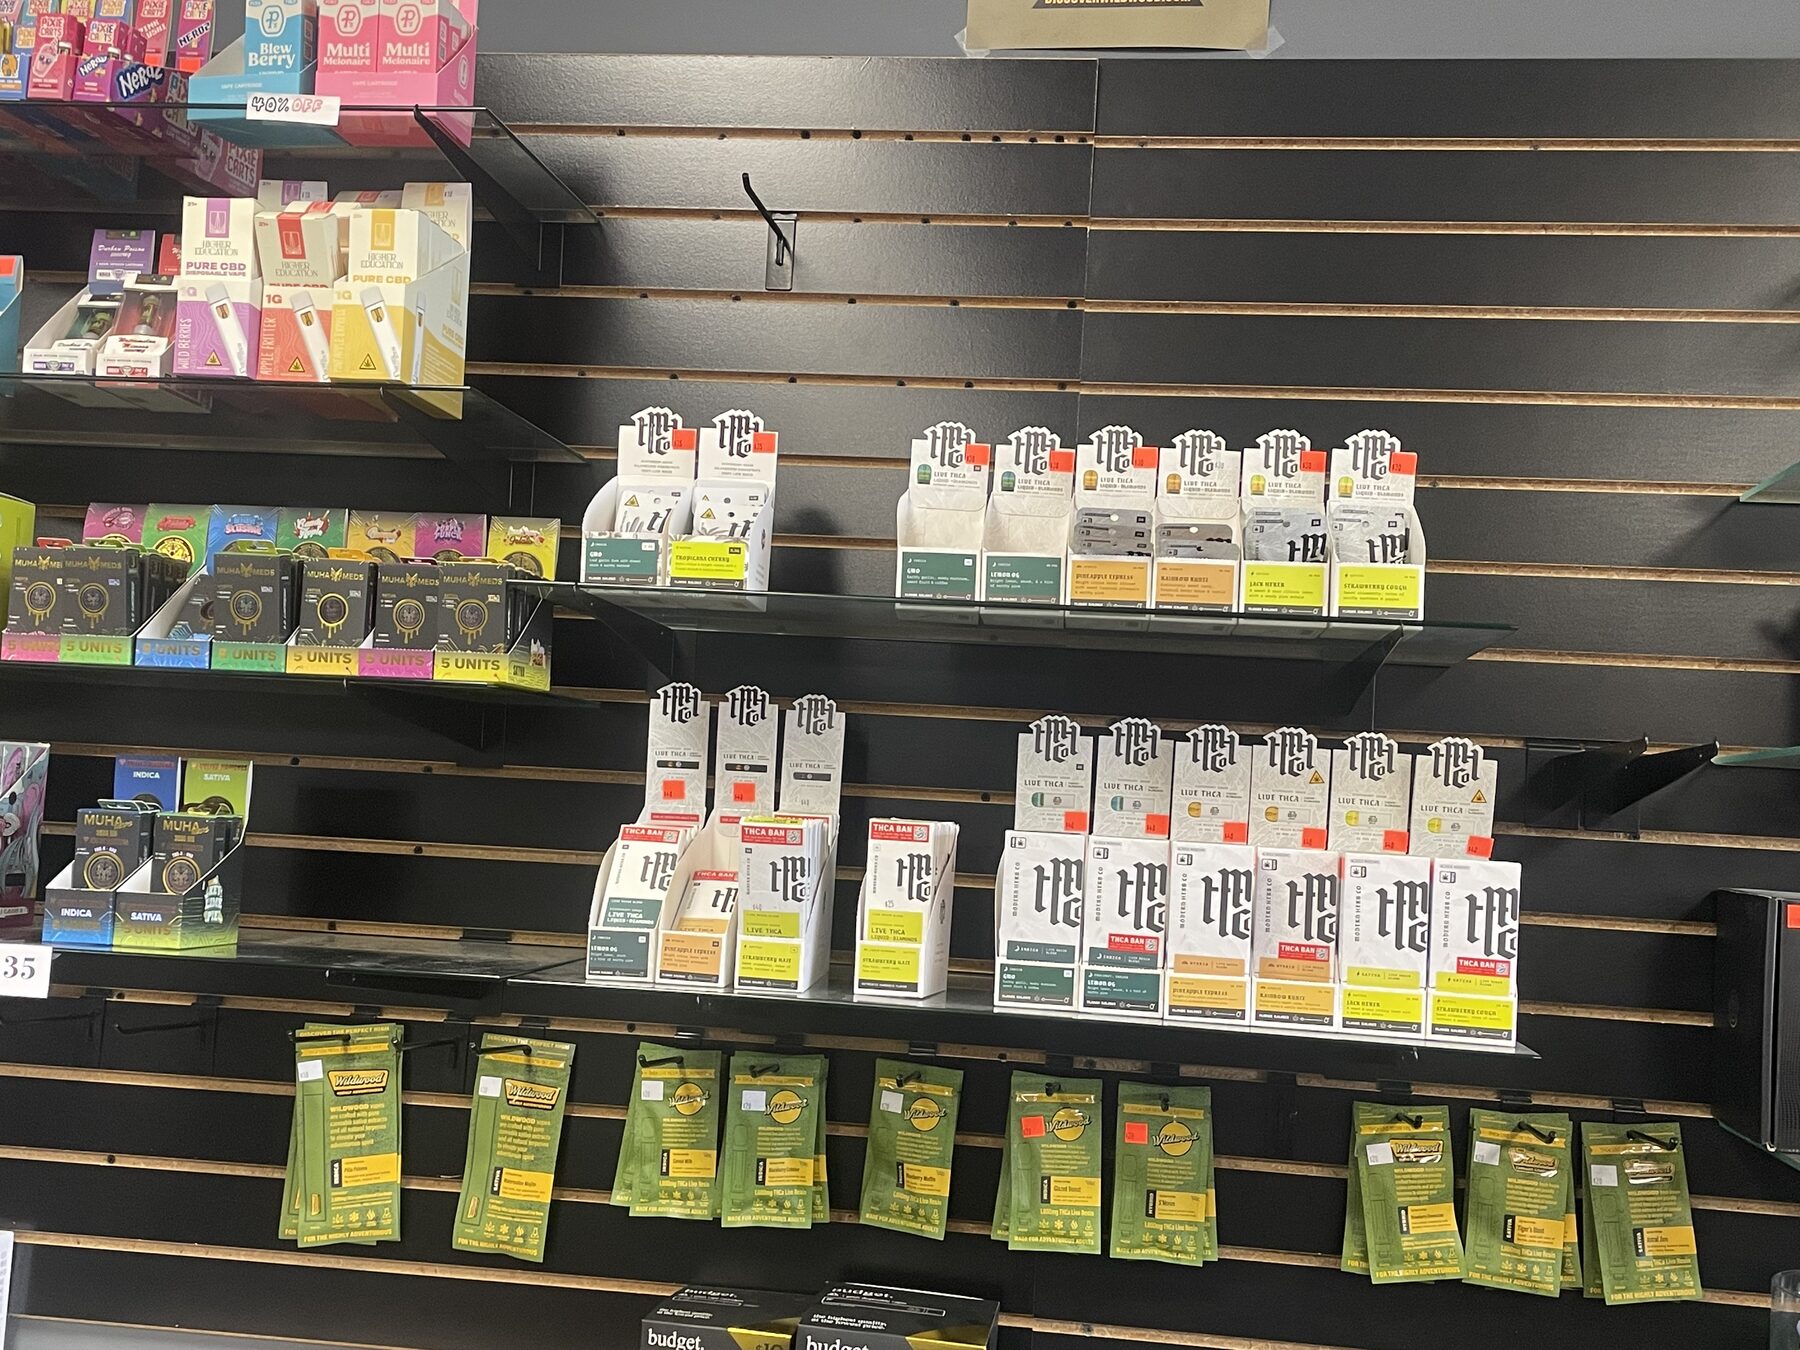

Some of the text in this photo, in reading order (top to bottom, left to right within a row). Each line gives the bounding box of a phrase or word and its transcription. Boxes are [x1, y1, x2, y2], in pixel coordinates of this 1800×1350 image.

[42, 17, 63, 27] PIXIE
[260, 43, 292, 54] Blew
[326, 42, 371, 57] Multi
[385, 42, 430, 57] Multi
[248, 53, 296, 69] Berry
[323, 56, 371, 67] Melonaire
[382, 56, 431, 67] Melonaire
[251, 96, 289, 112] 40%
[291, 97, 323, 113] OFF
[227, 155, 256, 185] CARTS
[201, 240, 232, 249] HIGHER
[194, 248, 239, 256] EDUCATION
[368, 252, 397, 262] HIGHER
[186, 261, 247, 272] PURE CBD
[281, 261, 310, 270] HIGHER
[360, 260, 404, 269] EDUCATION
[275, 269, 319, 278] EDUCATION
[352, 275, 411, 284] PURE CBD
[177, 317, 193, 369] WILD BERRIES
[259, 316, 278, 376] APPLE FRITTER
[65, 560, 122, 569] MUHA MEDS
[217, 566, 275, 576] MUHA MEDS
[307, 570, 364, 581] MUHA MEDS
[381, 575, 439, 586] MUHA MEDS
[443, 575, 503, 585] MUHA MEDS
[1344, 582, 1385, 591] STRAWBERRY
[67, 641, 123, 654] 5 UNITS
[293, 652, 352, 664] 5 UNITS
[441, 657, 501, 671] 5 UNITS
[133, 771, 160, 779] INDICA
[203, 773, 231, 782] SATIVA
[1024, 779, 1064, 788] LIVE THCA
[1104, 782, 1144, 792] LIVE THCA
[1201, 790, 1222, 798] THCA
[1257, 793, 1299, 803] LIVE THCA
[1338, 797, 1380, 807] LIVE THCA
[1420, 805, 1463, 814] LIVE THCA
[743, 827, 785, 837] THCA BAN
[873, 823, 913, 833] THCA BAN
[61, 907, 92, 918] INDICA
[130, 911, 163, 922] SATIVA
[889, 928, 906, 936] THCA
[1111, 935, 1145, 945] THCA BAN
[1280, 945, 1300, 953] THCA
[3, 957, 36, 980] 35
[1459, 959, 1495, 969] THCA BAN
[1087, 979, 1107, 987] LEMON
[334, 1072, 384, 1087] Wildwood
[509, 1084, 554, 1101] Wildwood
[330, 1103, 369, 1112] WILDWOOD
[764, 1098, 808, 1115] Wildwood
[500, 1114, 536, 1124] WILDWOOD
[904, 1107, 946, 1121] Wildwood
[1045, 1115, 1092, 1133] Wildwood
[1152, 1131, 1200, 1146] Wildwood
[493, 1169, 502, 1192] SATIVA
[752, 1215, 787, 1223] ADVENTUROUS
[303, 1235, 315, 1243] FOR
[329, 1232, 349, 1240] HIGHLY
[350, 1228, 392, 1239] ADVENTUROUS
[458, 1237, 469, 1246] FOR
[469, 1239, 479, 1247] THE
[499, 1243, 537, 1256] ADVENTUROUS
[1634, 1291, 1655, 1299] HIGHLY
[1655, 1288, 1697, 1297] ADVENTUROUS
[647, 1327, 705, 1350] budget.
